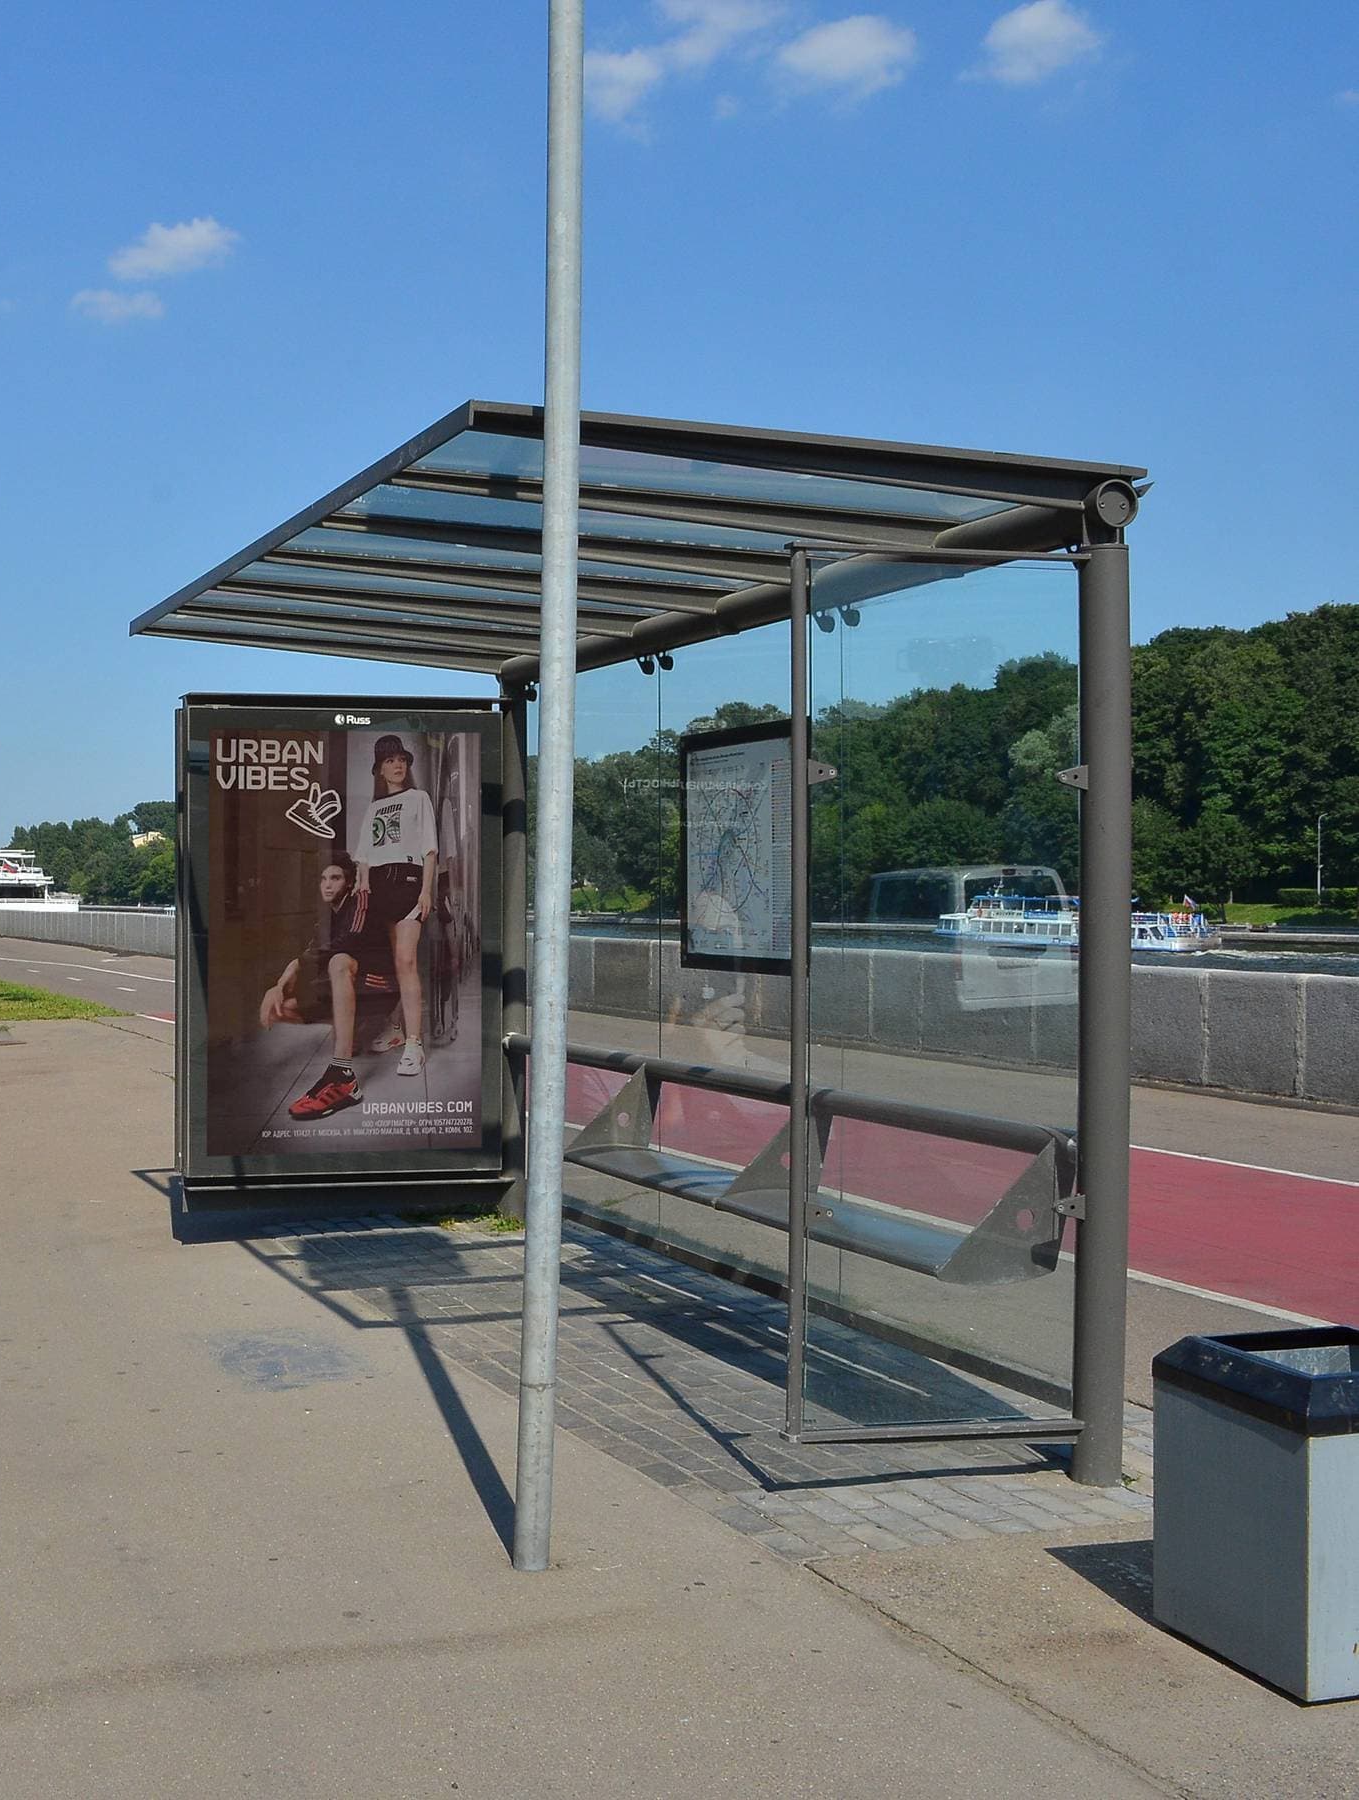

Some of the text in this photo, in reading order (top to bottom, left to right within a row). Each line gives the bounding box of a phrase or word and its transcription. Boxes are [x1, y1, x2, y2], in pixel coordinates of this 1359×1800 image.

[346, 715, 371, 724] Russ
[216, 738, 324, 765] URBAN
[216, 765, 310, 791] VIBES
[376, 803, 403, 816] PUMA
[362, 1101, 473, 1114] URBANVIBES.COM
